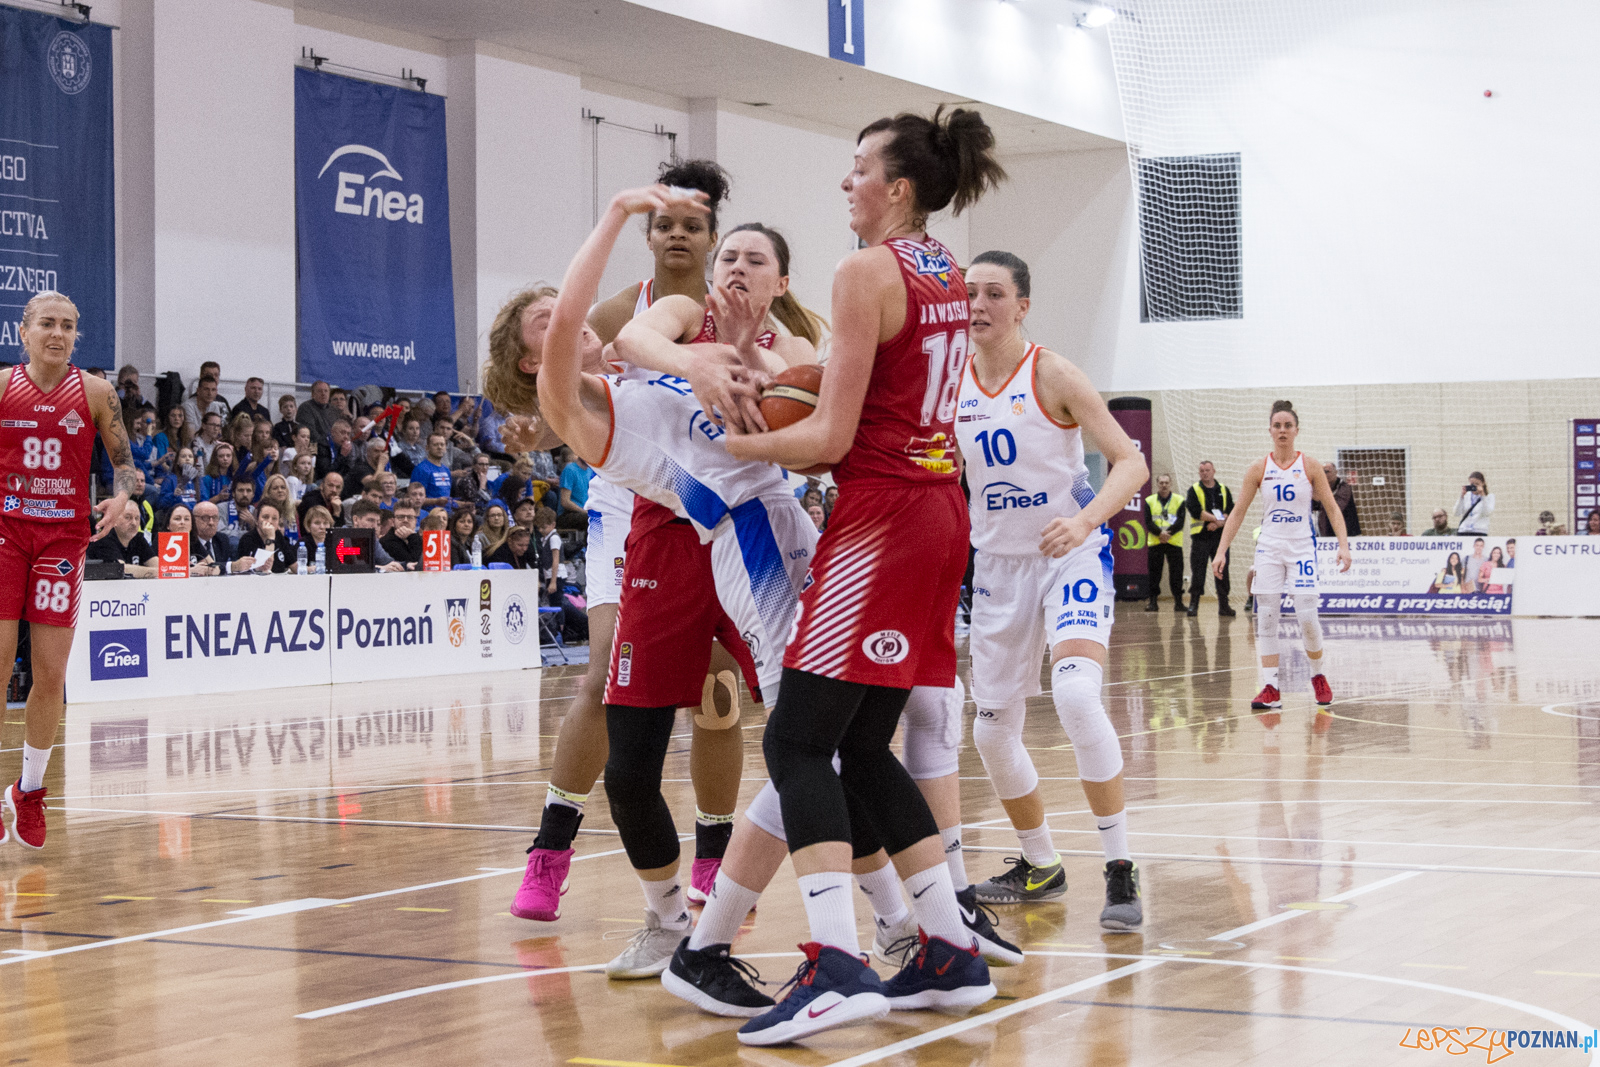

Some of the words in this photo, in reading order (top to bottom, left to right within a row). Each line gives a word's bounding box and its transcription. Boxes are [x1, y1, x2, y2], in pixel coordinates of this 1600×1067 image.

[0, 155, 26, 181] GO
[335, 171, 423, 224] Enea
[332, 340, 416, 365] www.enea.pl
[920, 329, 968, 427] 18
[22, 436, 62, 471] 88
[974, 428, 1017, 467] 10
[22, 498, 58, 508] POWIAT
[986, 491, 1048, 511] Enea
[1272, 484, 1296, 502] 16
[23, 507, 75, 518] OSTROWSKI
[1271, 514, 1303, 523] Enea
[162, 535, 183, 563] 5
[425, 533, 438, 558] 5
[1317, 541, 1355, 551] ZESPŁ
[1356, 539, 1386, 551] SZKÓŁ
[1389, 541, 1463, 551] BUDOWLANYCH
[1296, 560, 1314, 576] 16
[35, 579, 71, 613] 88
[1062, 579, 1099, 606] 10
[1318, 579, 1410, 588] ekretariat@zsb.com.pl
[1327, 596, 1383, 609] zawód
[1384, 599, 1396, 608] z
[1397, 596, 1511, 612] przyszłością!
[165, 612, 257, 660] ENEA
[264, 608, 325, 655] AZS
[337, 604, 433, 650] Poznań
[104, 652, 140, 668] Enea
